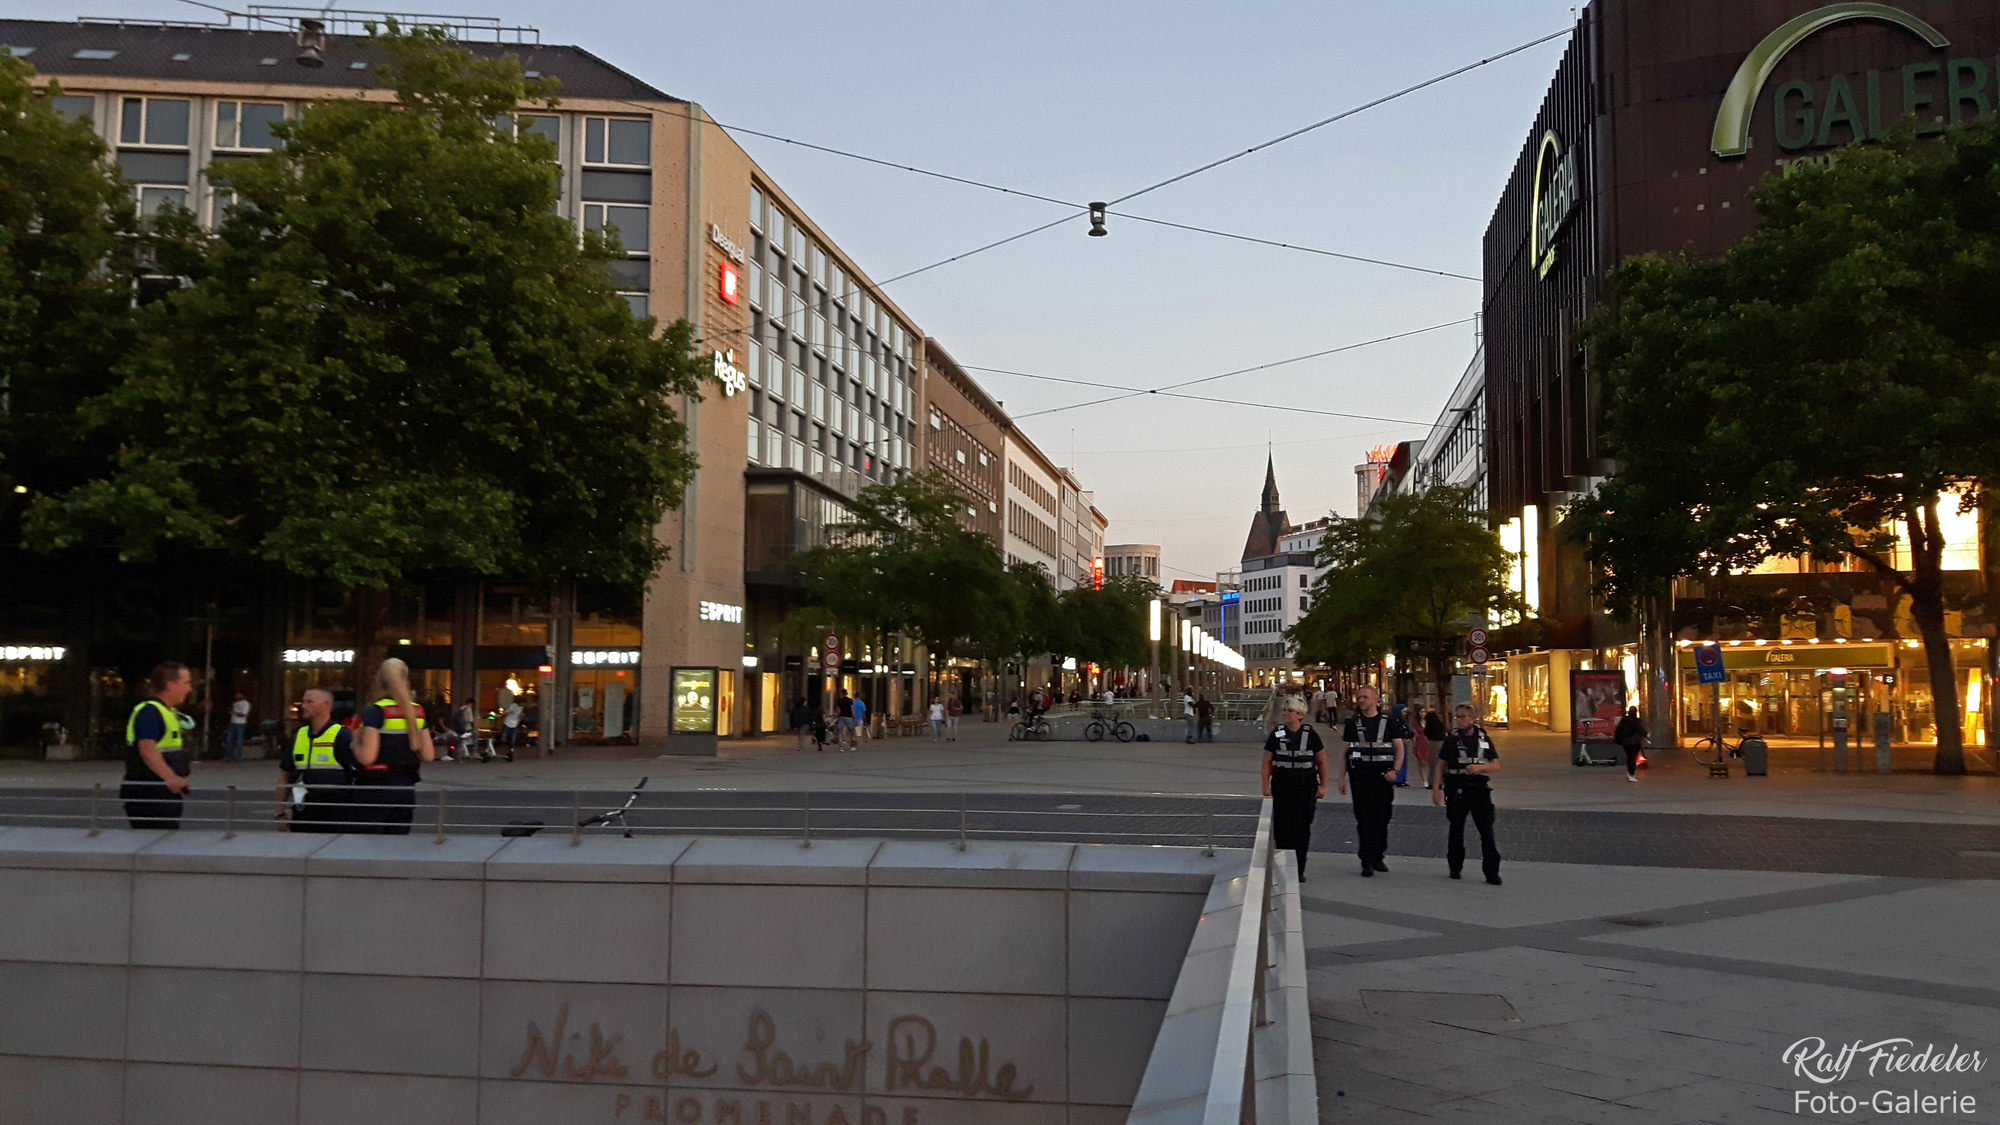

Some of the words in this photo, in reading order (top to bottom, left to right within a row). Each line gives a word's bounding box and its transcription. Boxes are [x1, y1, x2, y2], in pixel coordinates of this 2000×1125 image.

[1538, 144, 1578, 257] GALERIA
[714, 350, 746, 397] Regus
[699, 600, 742, 624] ESPRIT
[281, 649, 355, 663] ESPRIT
[570, 651, 640, 665] ESPRIT
[1770, 653, 1795, 663] GALERIA
[1702, 671, 1722, 681] TAXI
[508, 999, 628, 1078] Niki
[650, 1026, 719, 1081] de
[737, 1007, 872, 1090] Saint
[885, 1014, 1035, 1102] Phalle
[613, 1091, 920, 1125] PROMENADE
